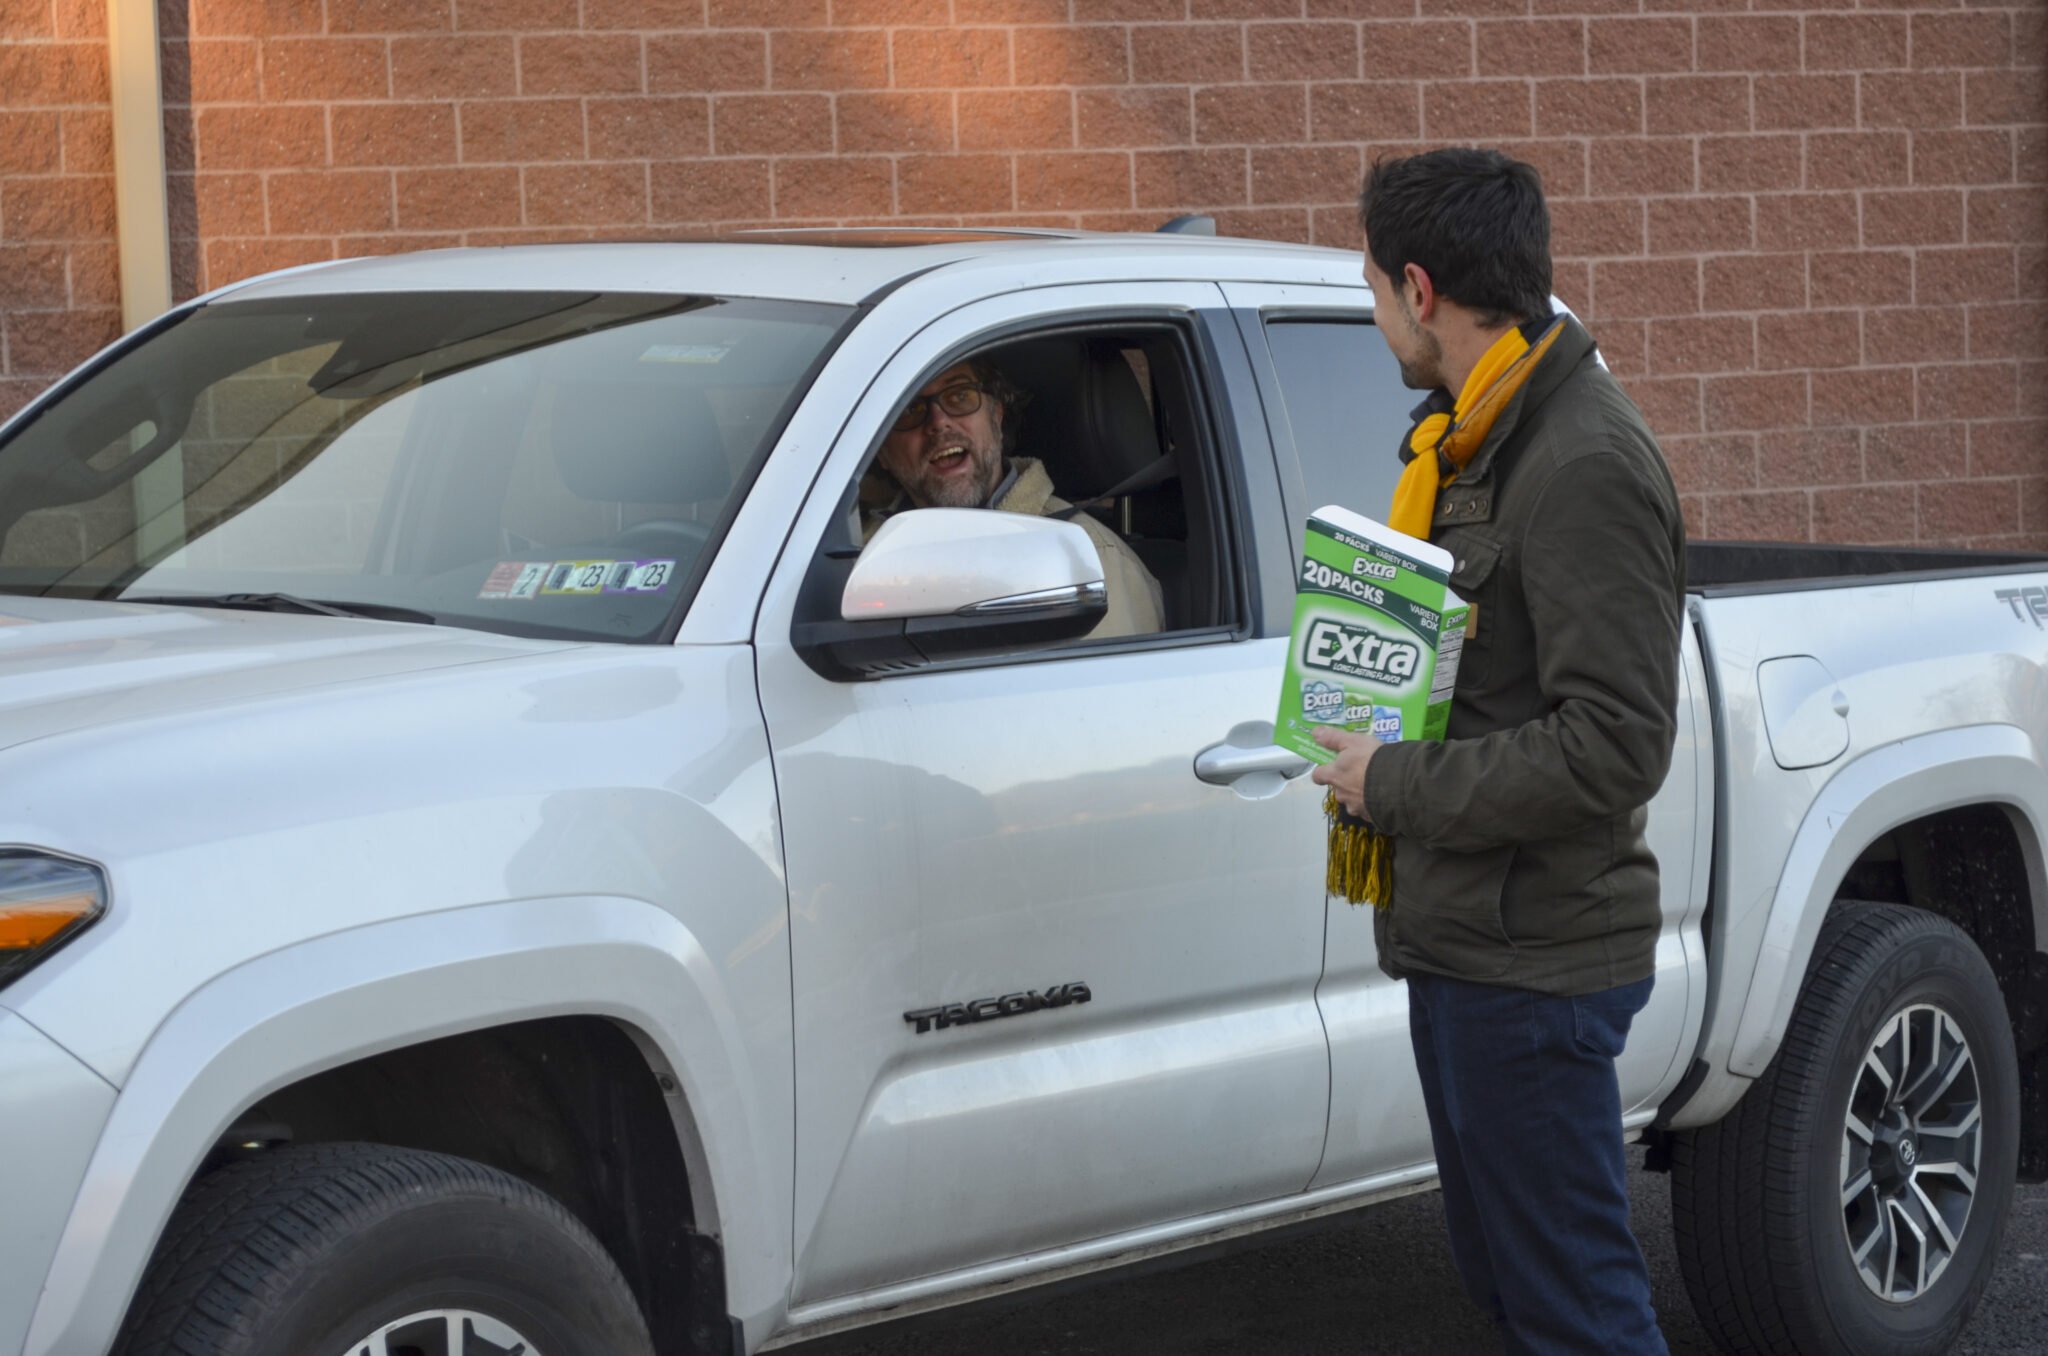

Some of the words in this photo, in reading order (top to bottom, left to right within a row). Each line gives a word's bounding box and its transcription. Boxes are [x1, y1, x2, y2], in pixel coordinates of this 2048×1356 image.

[1334, 532, 1345, 542] 20
[1345, 536, 1370, 552] PACKS
[1375, 549, 1402, 565] VARIETY
[1402, 560, 1418, 572] BOX
[581, 565, 604, 588] 23
[643, 564, 666, 587] 23
[1353, 557, 1397, 578] Extra
[1409, 604, 1440, 622] VARIETY
[1994, 586, 2048, 631] TR
[1421, 617, 1439, 631] BOX
[1306, 622, 1417, 677] Extra
[1333, 662, 1351, 673] LONG
[1351, 665, 1377, 679] LASTING
[1376, 673, 1401, 684] FLAVOR
[1304, 691, 1342, 711] Extra
[1346, 705, 1371, 720] xtra
[1374, 717, 1399, 732] xtra
[903, 981, 1091, 1034] TACOMA
